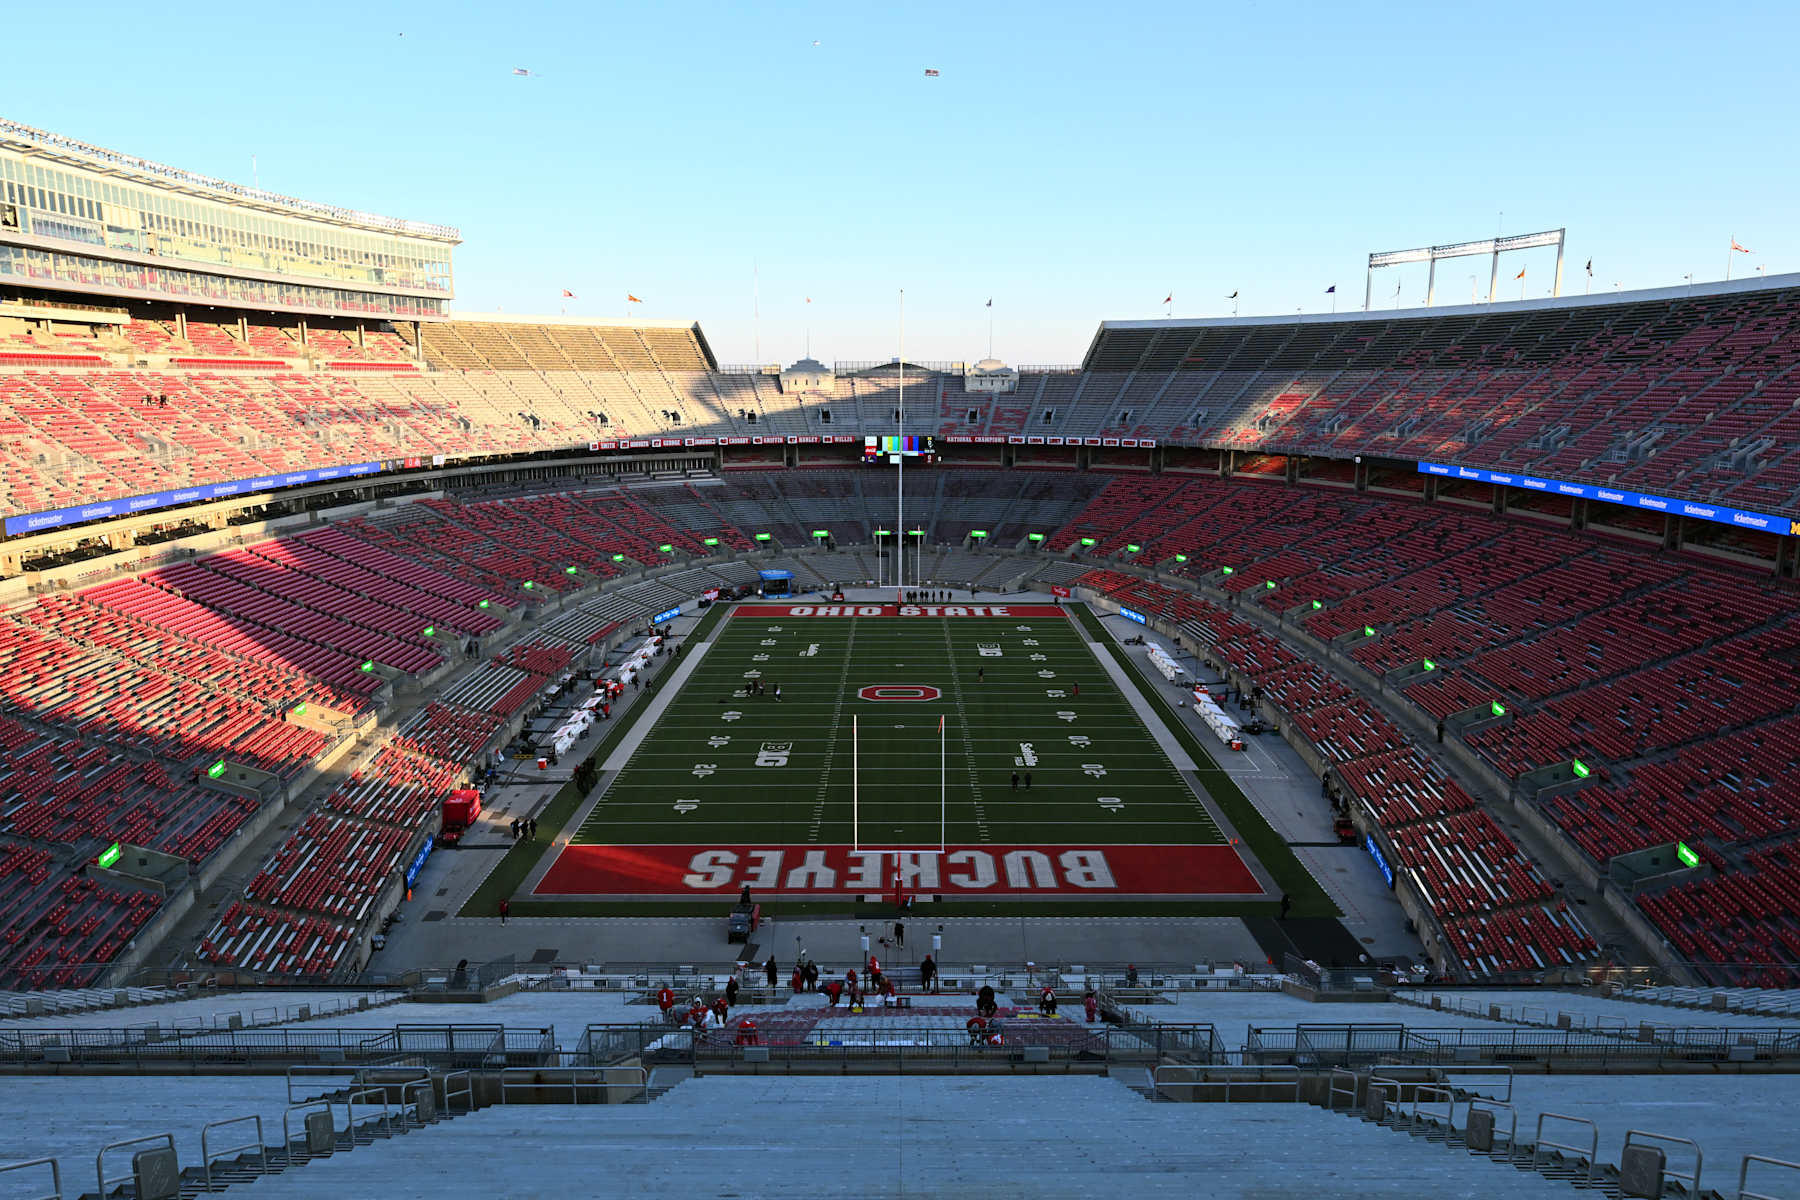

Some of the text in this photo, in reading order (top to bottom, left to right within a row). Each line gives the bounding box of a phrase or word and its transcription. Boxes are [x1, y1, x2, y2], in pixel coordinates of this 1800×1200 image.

[1639, 497, 1667, 509] ticketmaster
[1684, 504, 1716, 518] ticketmaster
[1733, 513, 1769, 528] ticketmaster
[28, 514, 63, 528] ticketmaster
[789, 606, 1010, 616] OHIO STATE
[692, 764, 718, 775] 20
[1081, 764, 1107, 776] 20
[673, 799, 700, 810] 10
[1097, 797, 1125, 808] 10
[682, 850, 1118, 889] BUCKEYES
